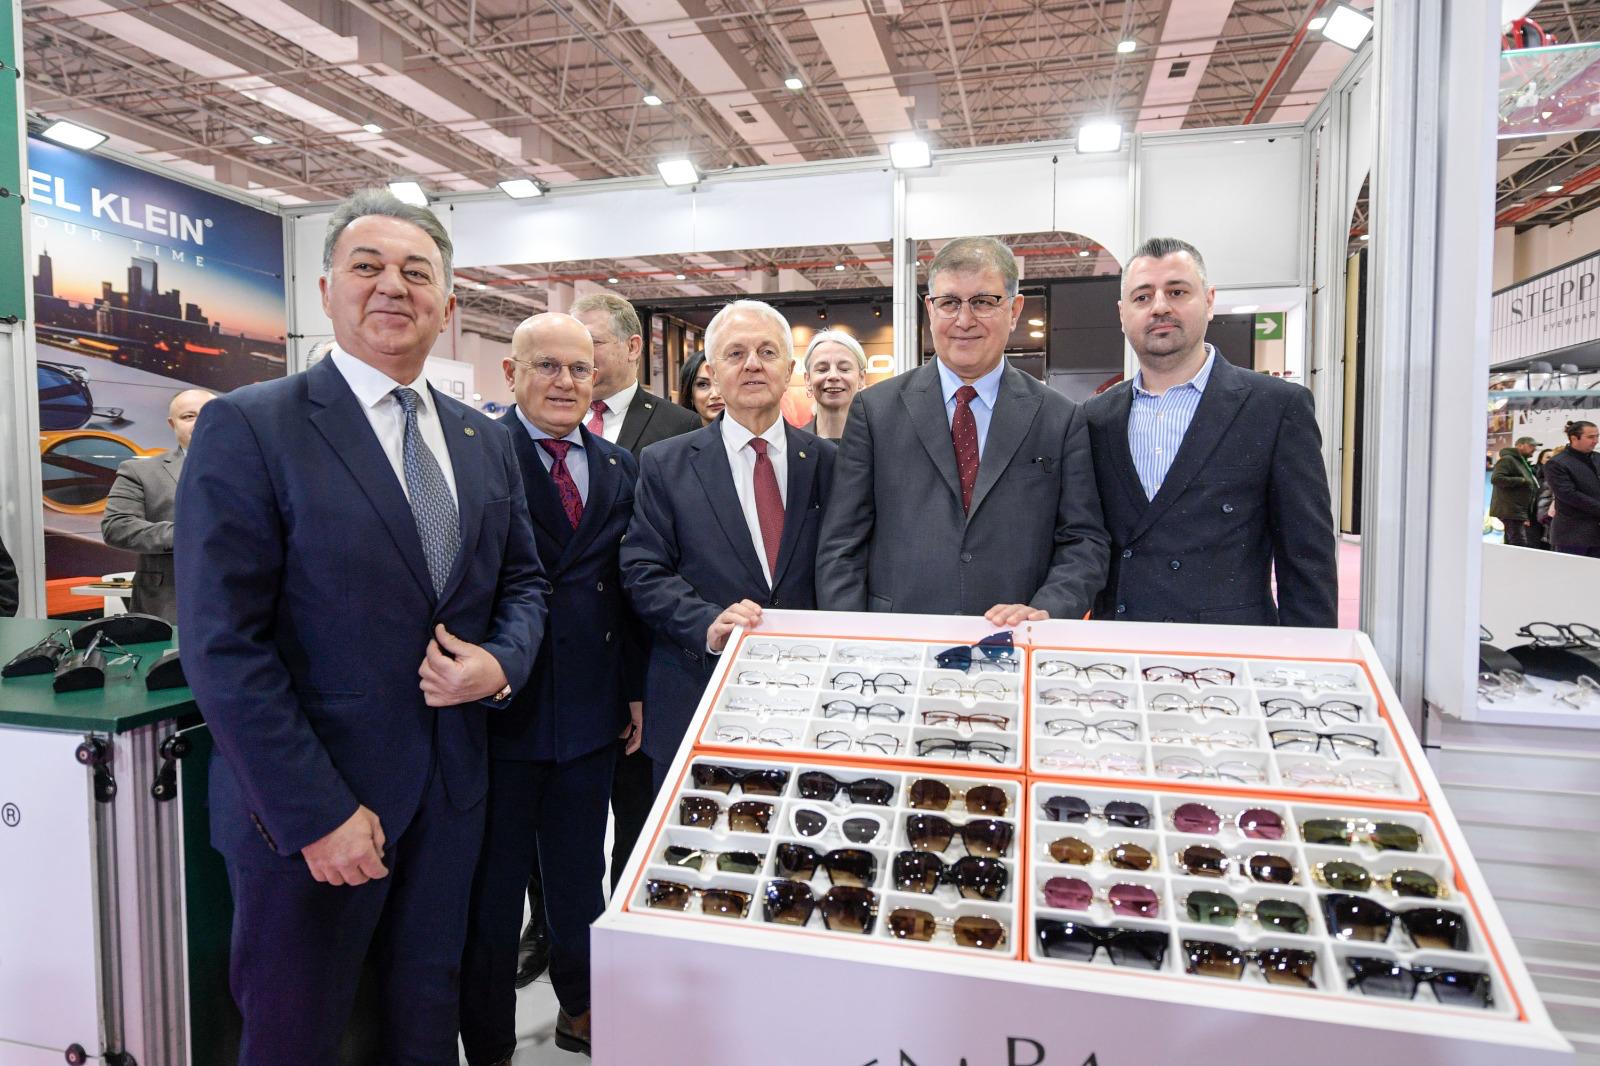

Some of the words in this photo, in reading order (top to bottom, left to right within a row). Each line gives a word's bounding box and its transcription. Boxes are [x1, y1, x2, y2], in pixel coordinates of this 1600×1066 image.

[131, 239, 205, 268] TIME
[1512, 272, 1596, 324] STEPP
[1543, 310, 1597, 332] EYEWEAR
